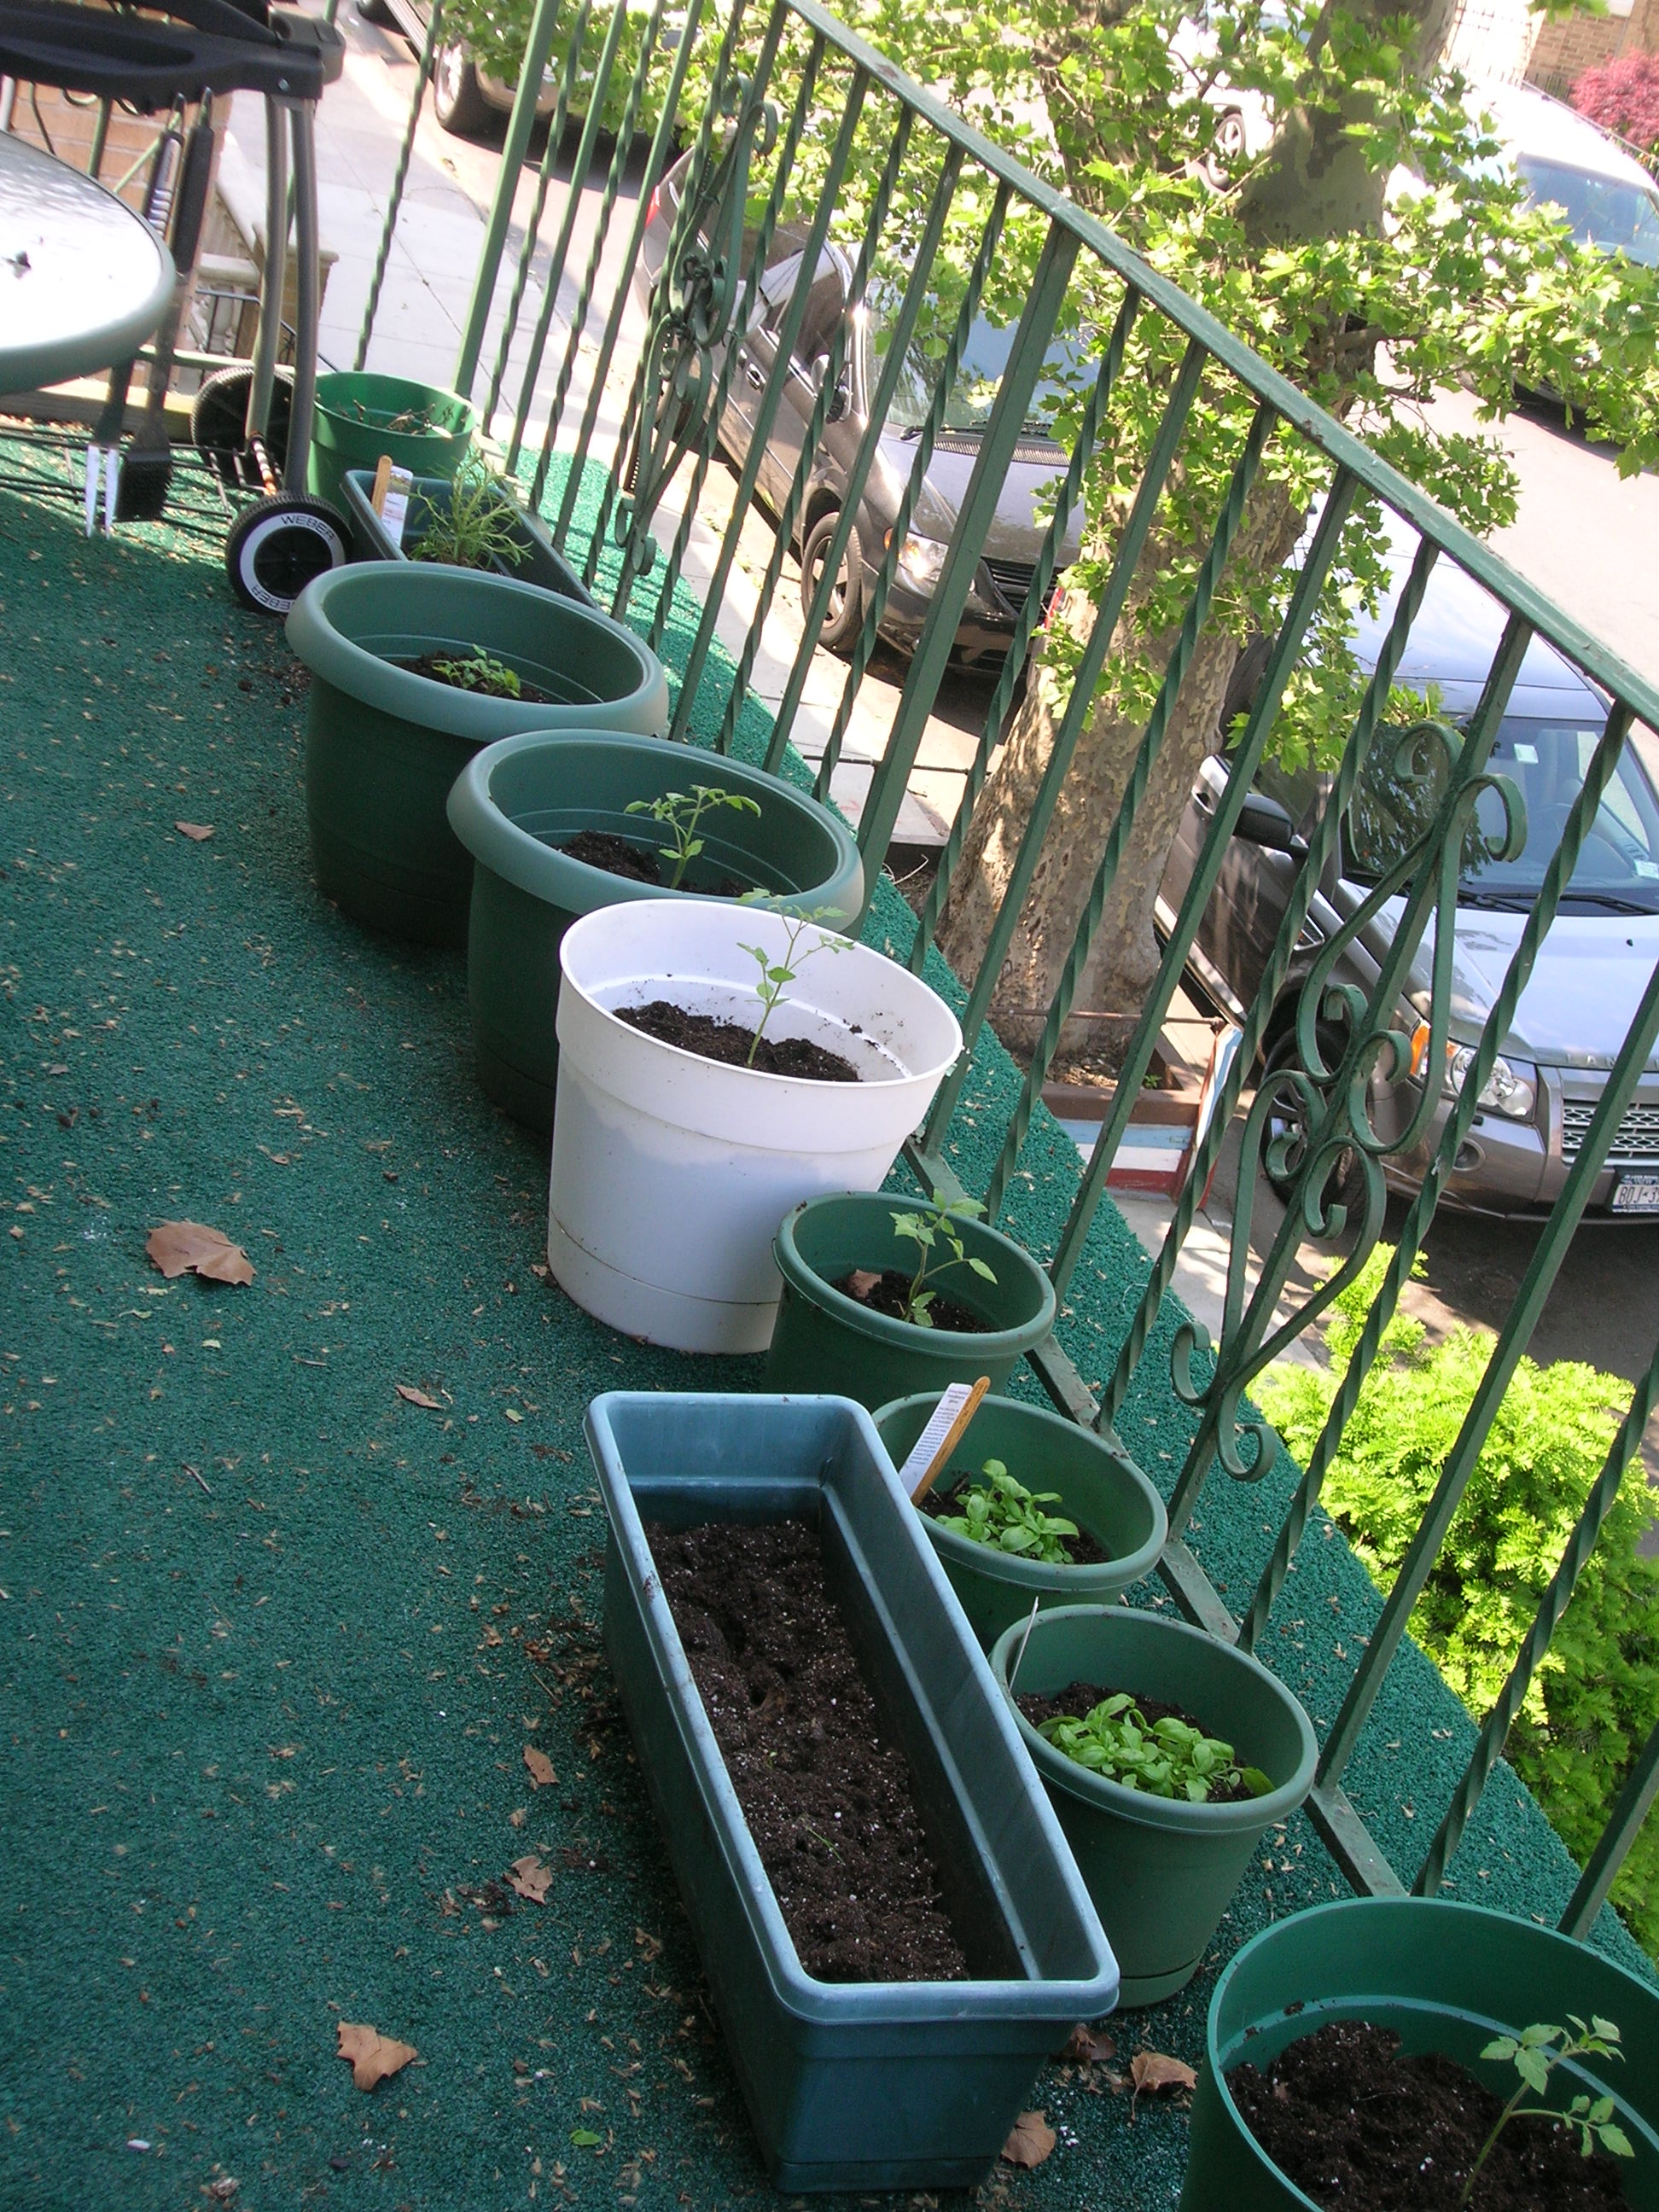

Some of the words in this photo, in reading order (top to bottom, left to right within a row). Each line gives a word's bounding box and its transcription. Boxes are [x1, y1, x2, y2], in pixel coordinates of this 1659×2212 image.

[281, 515, 335, 540] WEBER
[252, 585, 295, 610] EBER
[1565, 1052, 1616, 1067] LAN
